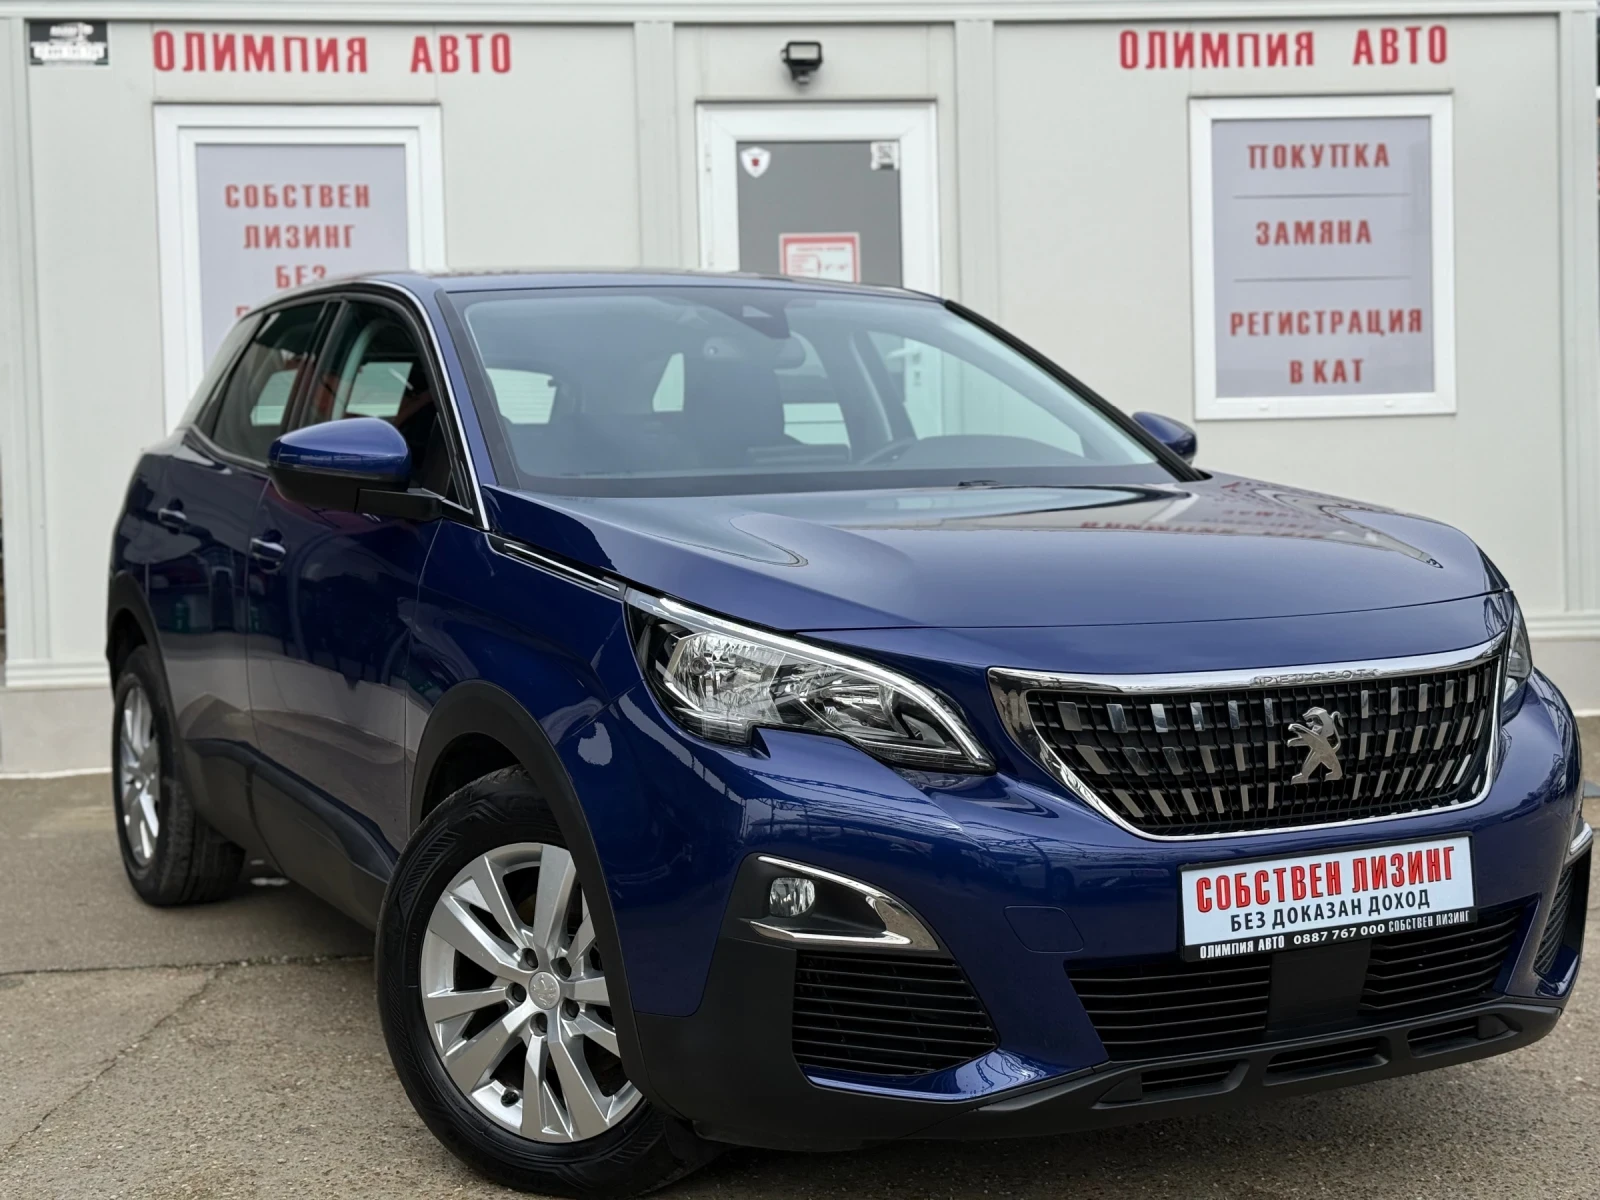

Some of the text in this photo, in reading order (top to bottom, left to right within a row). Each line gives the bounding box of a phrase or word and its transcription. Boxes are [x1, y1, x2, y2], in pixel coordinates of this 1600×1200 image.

[152, 30, 368, 74] ОЛИМПИЯ
[409, 32, 512, 74] АВТО
[1119, 25, 1448, 70] ОЛИМПИЯ АВТО
[1247, 143, 1390, 169] ПОКУПКА
[224, 184, 370, 208] СОБСТВЕН
[244, 225, 354, 249] ЛИЗИНГ
[1256, 220, 1372, 246] ЗАМЯНА
[1230, 308, 1422, 335] РЕГИСТРАЦИЯ
[1289, 359, 1364, 384] В КАТ
[1196, 847, 1455, 912] СОБСТВЕН ЛИЗИНГ
[1230, 888, 1431, 933] БЕЗ ДОКАЗАН ДОХОД
[1199, 910, 1470, 960] ОЛИМПИЯ АВТО 0887 767 000 СОБСТВЕН ЛИЗИНГ
